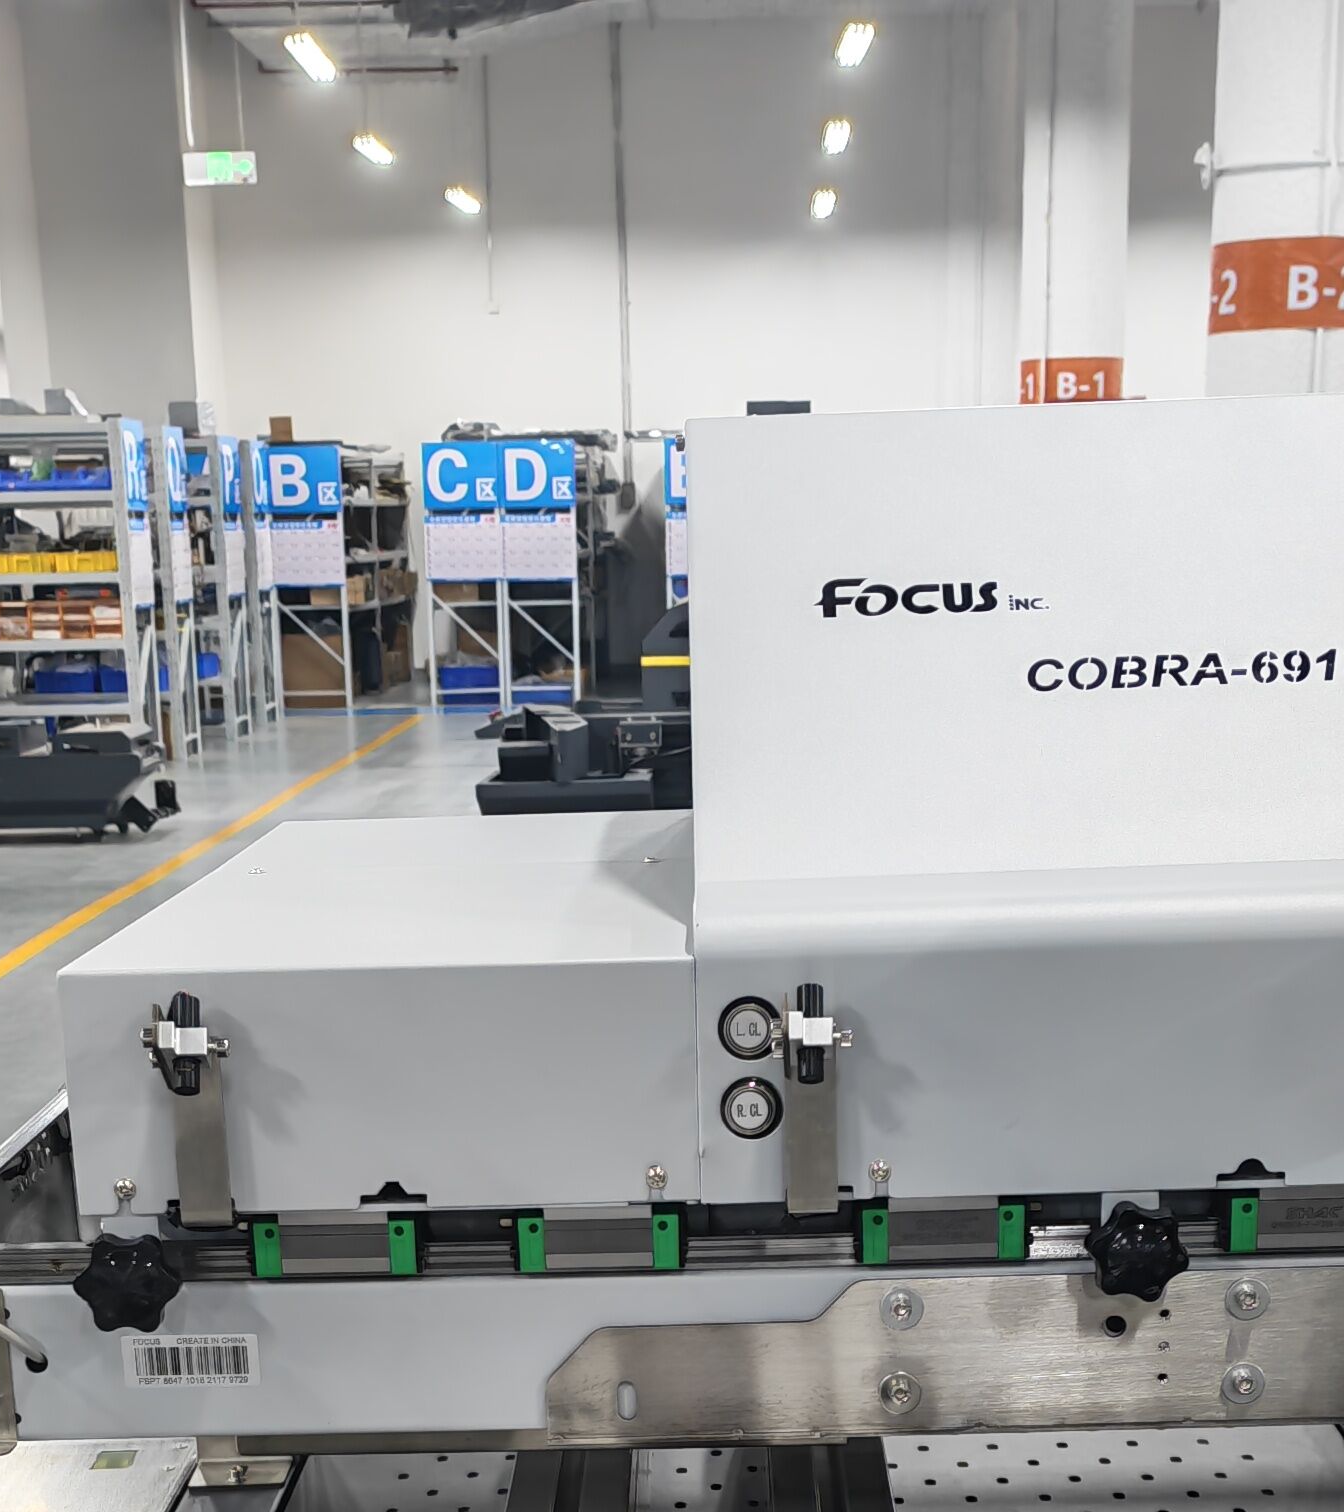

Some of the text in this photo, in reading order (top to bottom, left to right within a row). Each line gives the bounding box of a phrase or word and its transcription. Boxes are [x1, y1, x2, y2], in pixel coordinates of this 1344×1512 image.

[1056, 370, 1106, 400] B-1
[814, 577, 999, 618] FOCUS
[133, 1338, 161, 1346] FOCUS
[176, 1336, 247, 1345] CREATE IN CHINA
